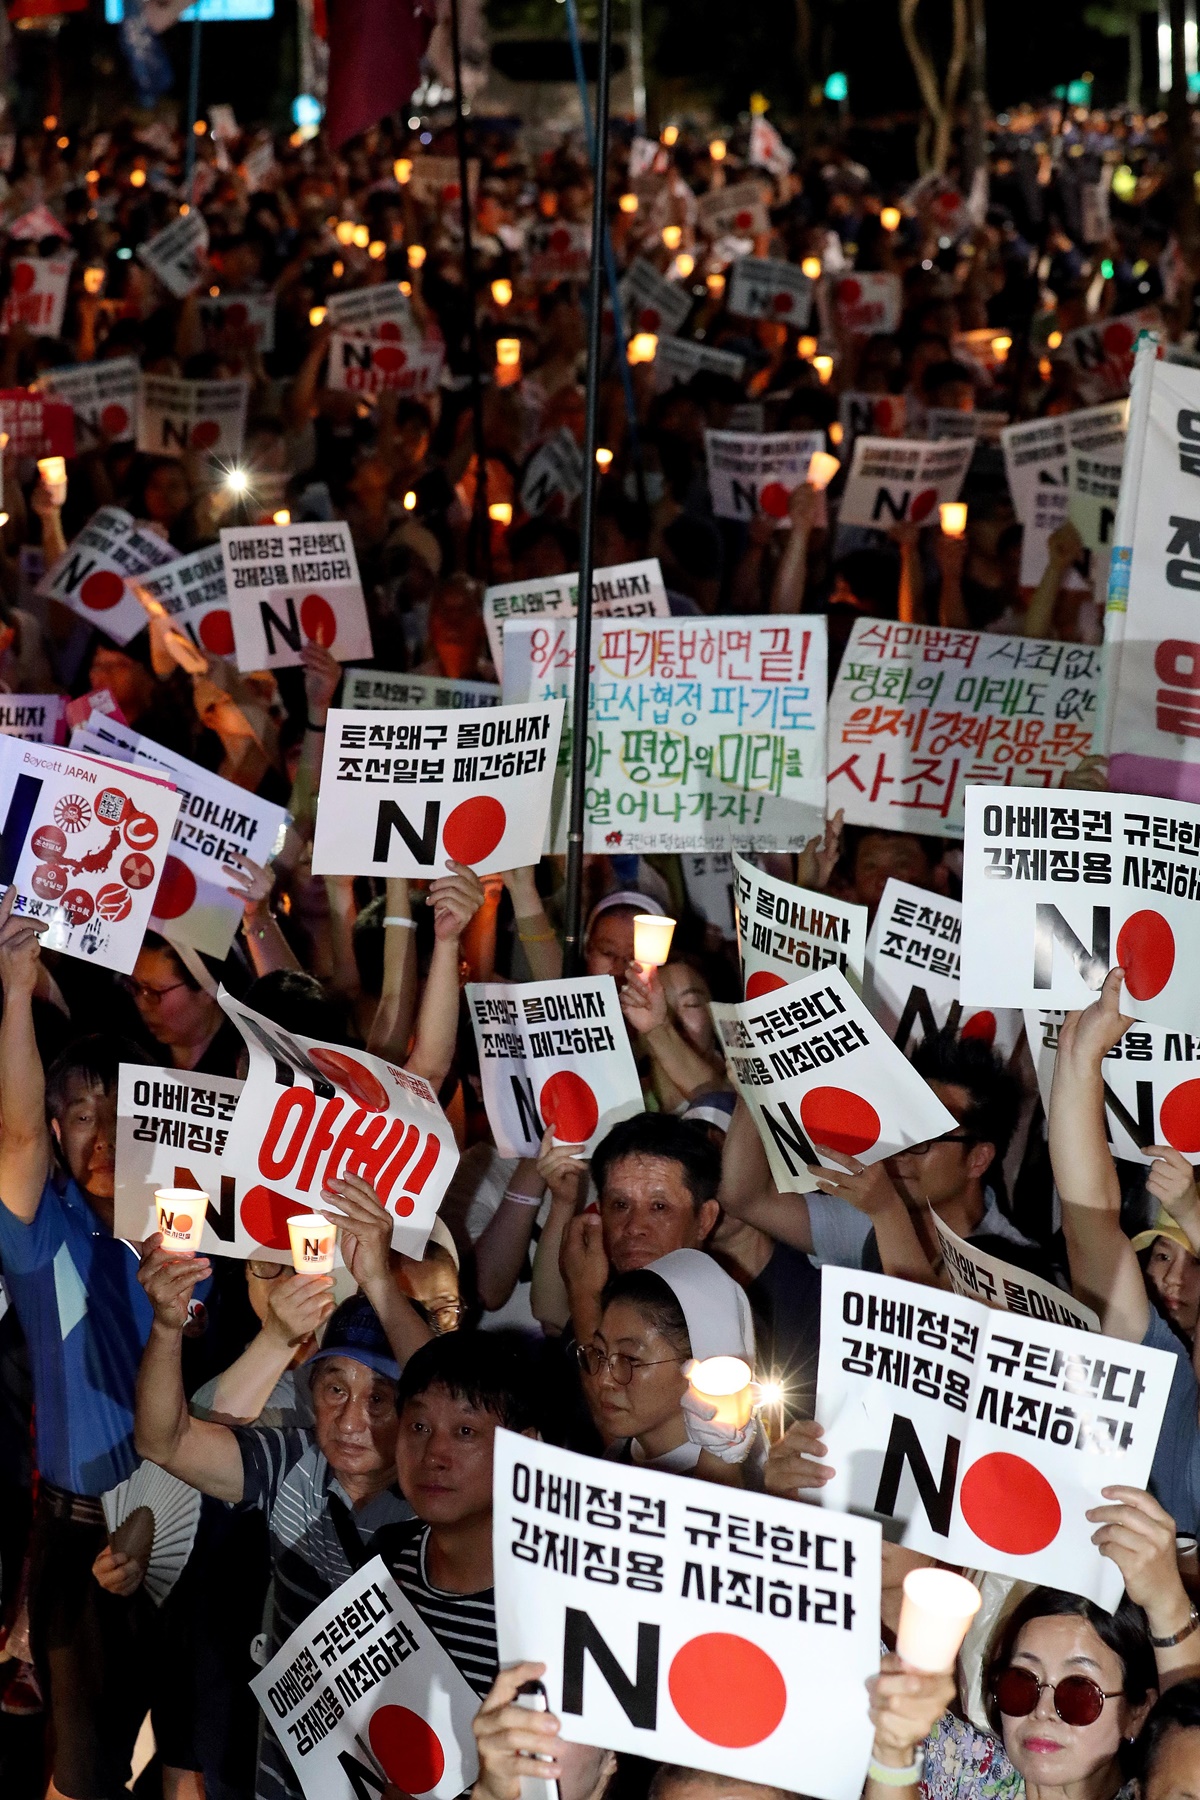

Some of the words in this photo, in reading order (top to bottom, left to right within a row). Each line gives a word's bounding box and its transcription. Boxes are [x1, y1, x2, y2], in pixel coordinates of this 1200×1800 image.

[288, 534, 346, 557] 규탄한다
[232, 564, 289, 589] 강제징용
[292, 558, 351, 584] 사죄하라
[760, 628, 812, 682] 끝!
[857, 624, 980, 669] 식민범죄
[709, 685, 816, 731] 파기로
[955, 675, 1049, 717] 미래도
[339, 724, 448, 751] 토착왜구
[457, 714, 551, 750] 몰아내자
[64, 763, 99, 785] JAPAN
[336, 756, 446, 784] 조선일보
[452, 747, 547, 783] 폐간하라
[621, 729, 714, 786] 평화의
[718, 733, 804, 798] 미래를
[983, 804, 1113, 843] 아베정권
[983, 847, 1113, 885] 강제징용
[1122, 854, 1200, 902] 사죄하
[756, 886, 851, 945] 몰아내자
[474, 999, 519, 1026] 토착왜구
[522, 991, 606, 1025] 몰아내자
[750, 985, 848, 1046] 규탄한다
[481, 1033, 527, 1060] 조선일보
[528, 1025, 616, 1059] 폐간하라
[768, 1019, 872, 1081] 사죄하라
[1163, 1032, 1200, 1062] 사
[842, 1290, 980, 1365] 아베정권
[986, 1333, 1146, 1409] 규탄한다
[842, 1337, 971, 1414] 강제징용
[975, 1386, 1134, 1458] 사죄하라
[512, 1462, 667, 1539] 아베정권
[684, 1505, 857, 1578] 규탄한다
[511, 1517, 665, 1594] 강제징용
[680, 1561, 856, 1631] 사죄하라
[267, 1646, 323, 1719] 아베정권
[311, 1582, 394, 1668] 규탄한다
[287, 1685, 345, 1757] 강제징용
[334, 1620, 421, 1708] 사죄하라
